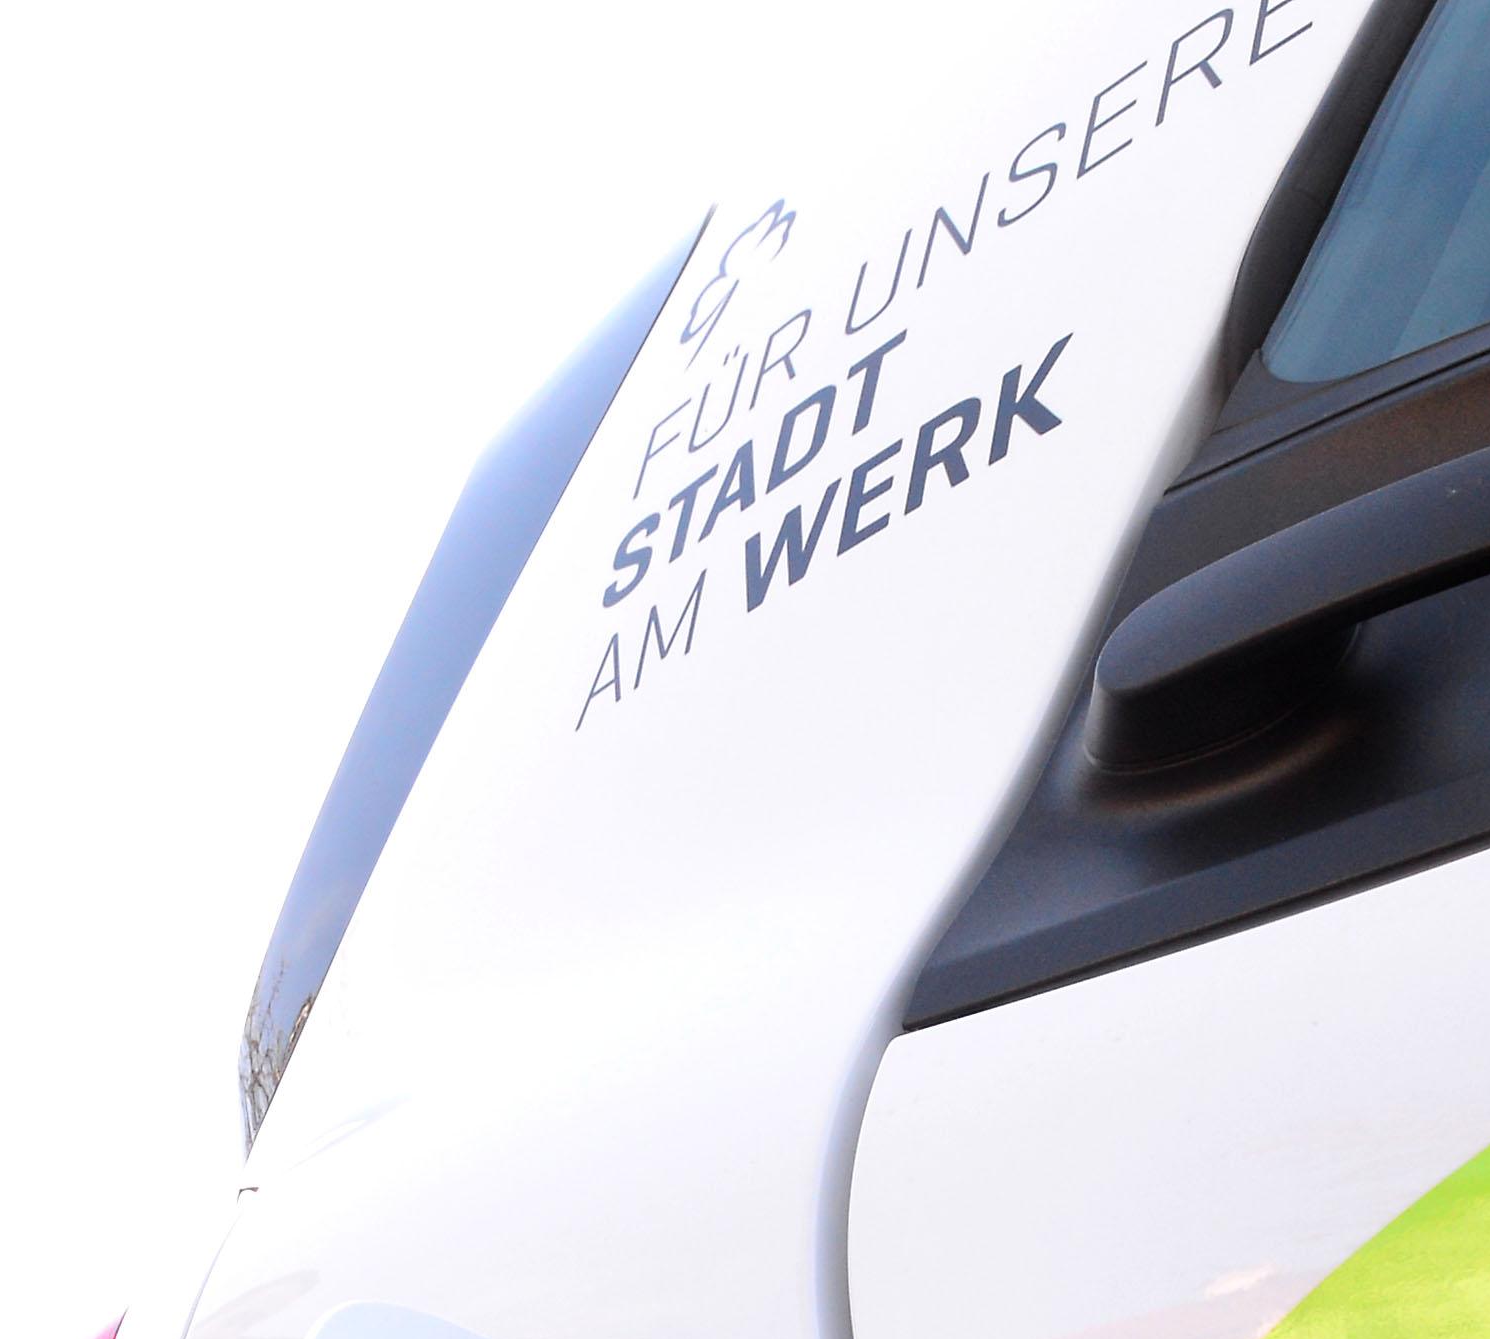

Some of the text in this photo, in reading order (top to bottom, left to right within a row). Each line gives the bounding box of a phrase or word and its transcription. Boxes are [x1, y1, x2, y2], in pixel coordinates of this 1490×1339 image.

[633, 0, 1313, 501] FÜR UNSERE
[575, 332, 1075, 733] AM WERK
[602, 329, 908, 609] STADT
